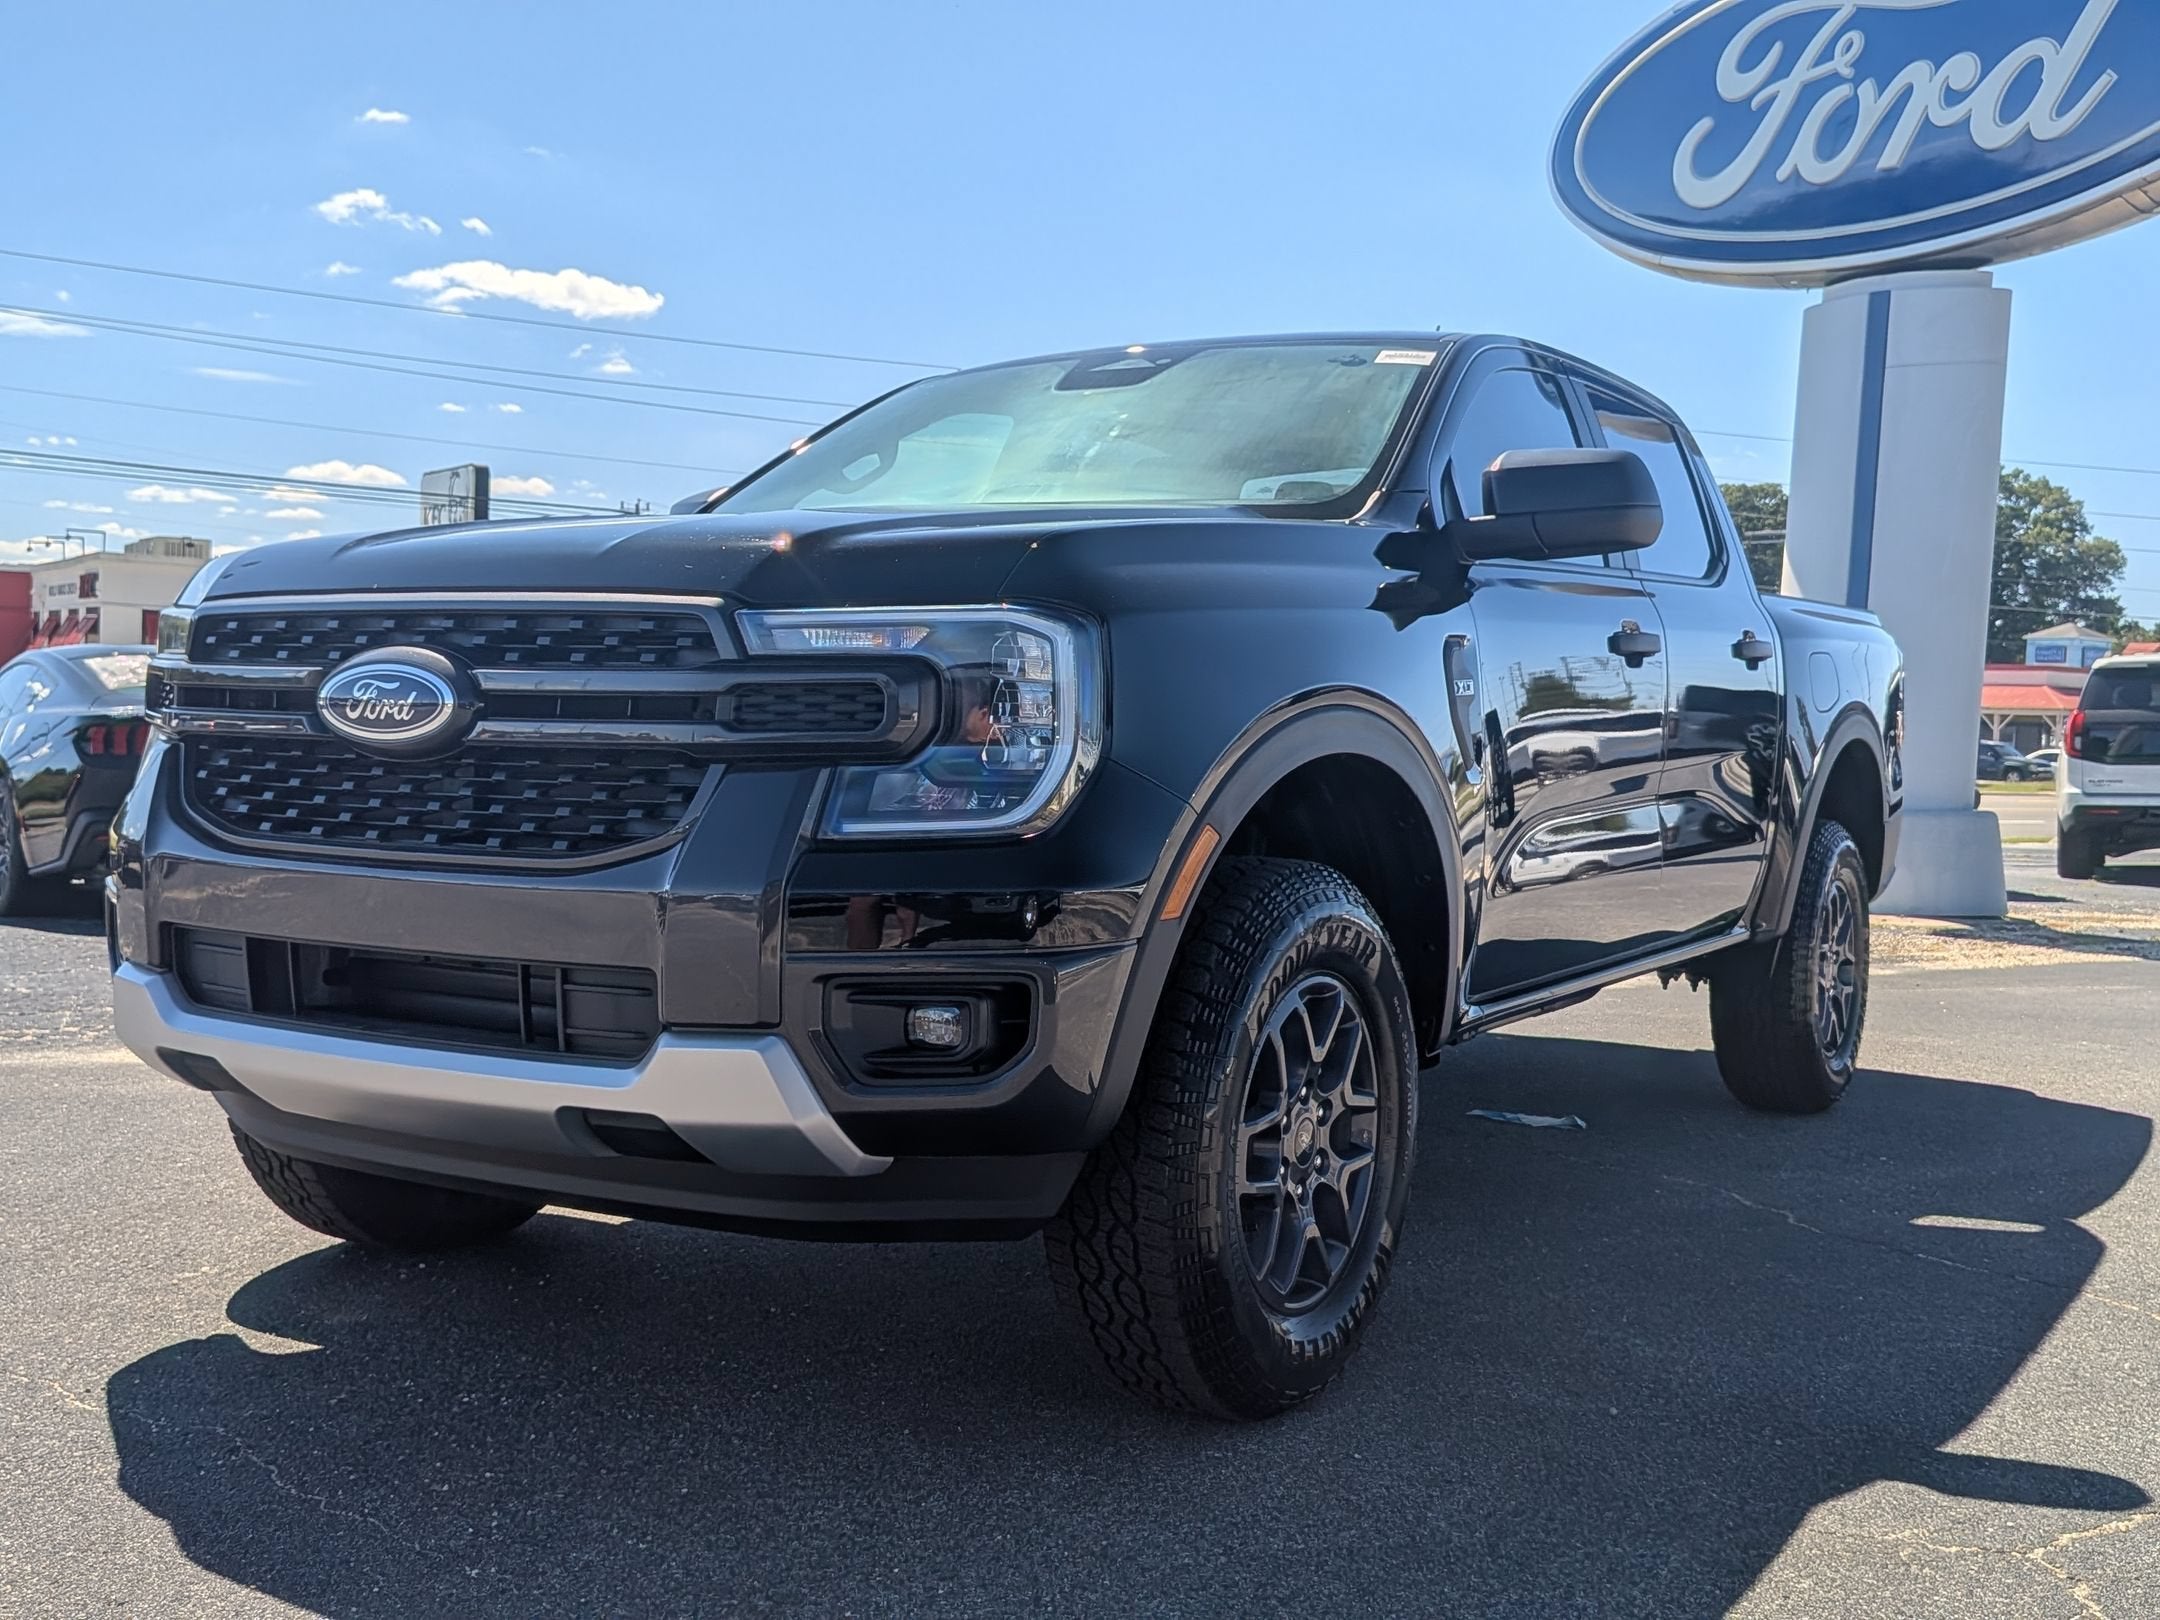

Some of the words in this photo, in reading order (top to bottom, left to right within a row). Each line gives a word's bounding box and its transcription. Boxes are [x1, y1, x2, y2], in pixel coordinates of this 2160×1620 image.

[1673, 0, 2118, 209] Ford
[345, 679, 418, 722] Ford
[1454, 680, 1475, 696] XLT
[1256, 921, 1377, 1033] GOODYEAR
